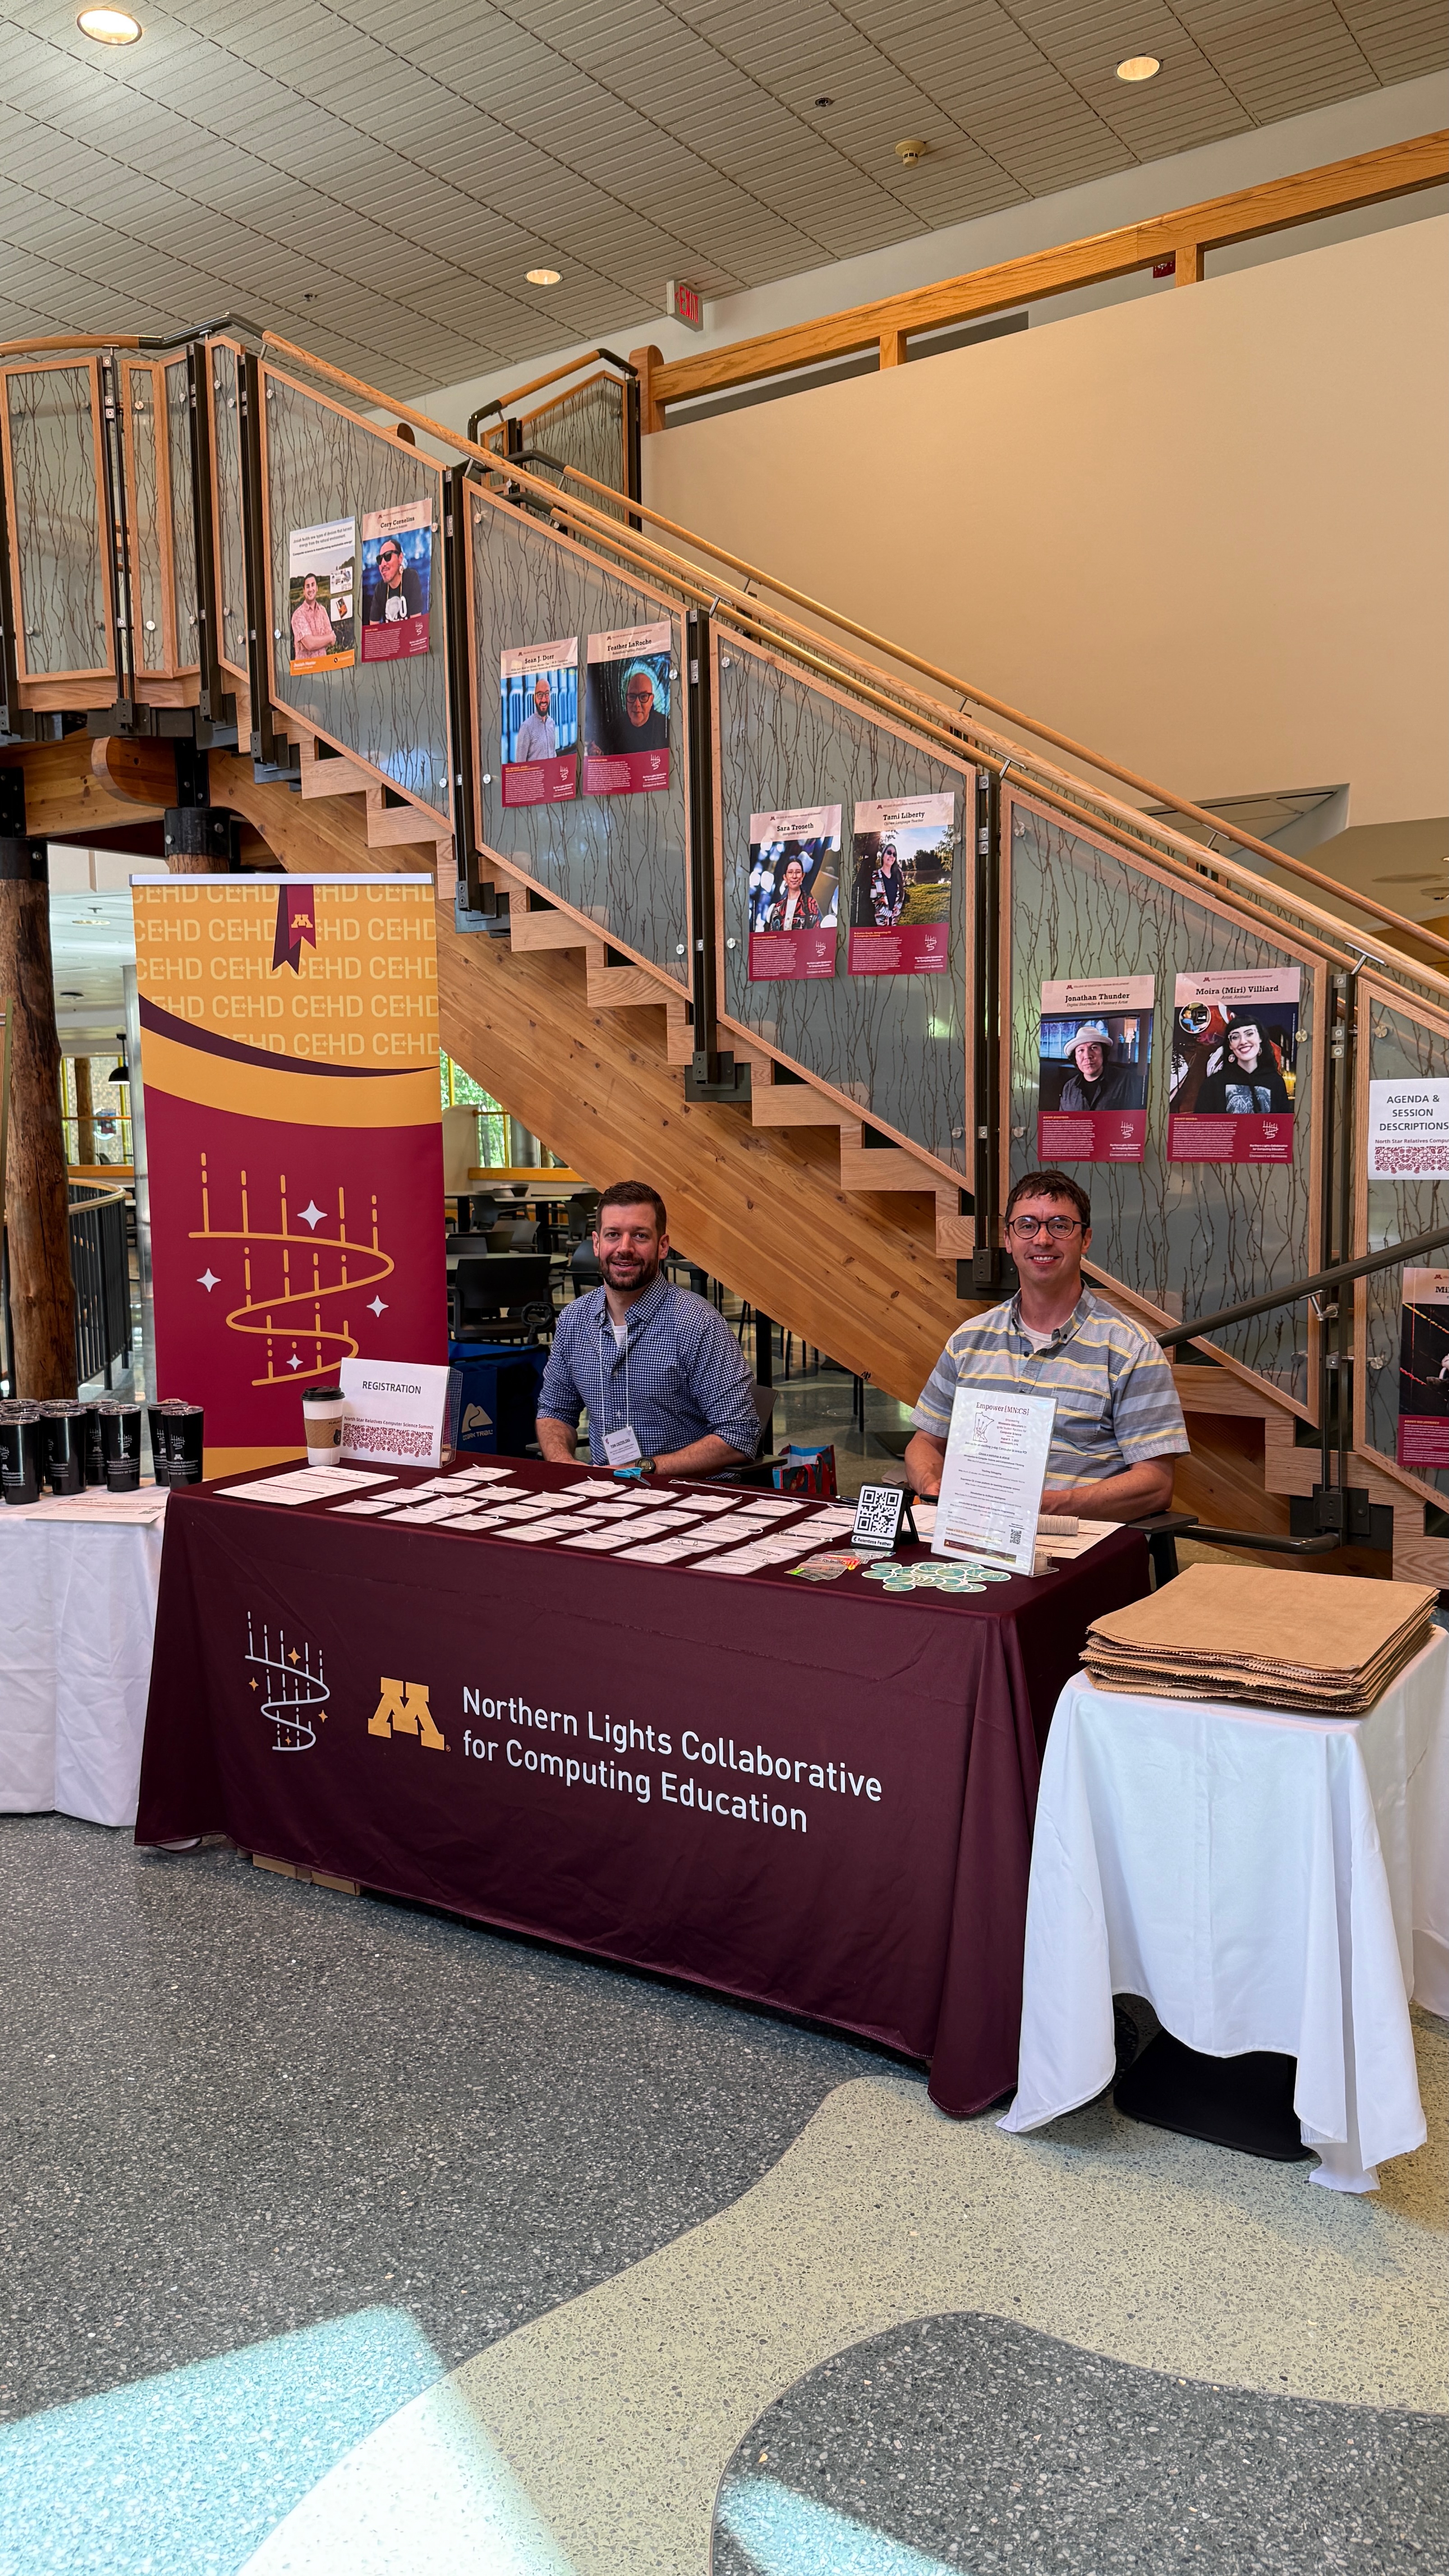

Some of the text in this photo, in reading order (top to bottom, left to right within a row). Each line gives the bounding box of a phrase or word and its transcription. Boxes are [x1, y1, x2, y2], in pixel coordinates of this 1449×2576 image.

[679, 285, 699, 323] EXIT
[607, 643, 627, 651] Feather
[628, 639, 652, 648] LaRoche
[1222, 986, 1246, 995] (Miri)
[1065, 995, 1097, 1003] Jonathan
[1387, 1095, 1429, 1104] AGENDA
[1392, 1109, 1433, 1117] SESSION
[1380, 1122, 1449, 1131] DESCRIPTIONS
[362, 1381, 422, 1394] REGISTRATION
[463, 1686, 882, 1802] Northern Lights Collaborative
[463, 1729, 807, 1833] for Computing Education
